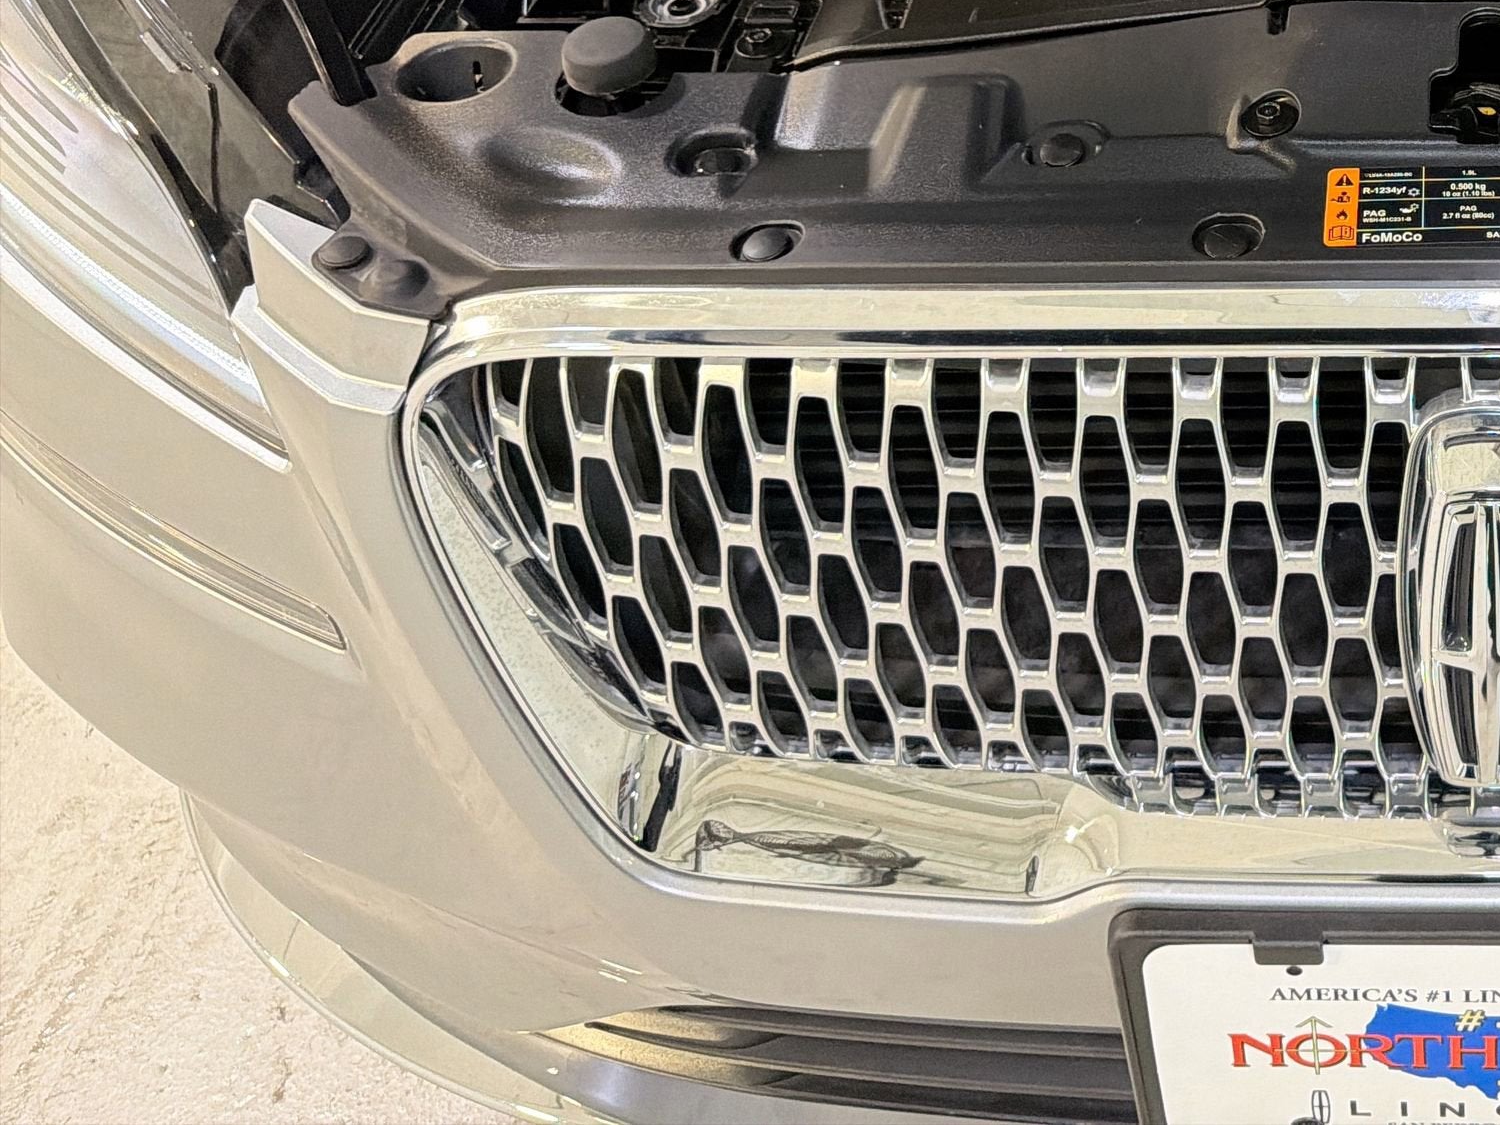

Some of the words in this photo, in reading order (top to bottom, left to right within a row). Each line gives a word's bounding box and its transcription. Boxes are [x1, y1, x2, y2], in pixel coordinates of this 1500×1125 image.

[1362, 185, 1407, 195] R-1234yf
[1450, 182, 1474, 190] 0.500
[1475, 182, 1487, 191] kg
[1363, 209, 1387, 218] PAG
[1442, 212, 1454, 220] 2.7
[1361, 231, 1423, 244] FoMoCo
[1269, 986, 1420, 1004] AMERICA'S
[1425, 987, 1455, 1004] #1
[1226, 1033, 1500, 1071] NORTH
